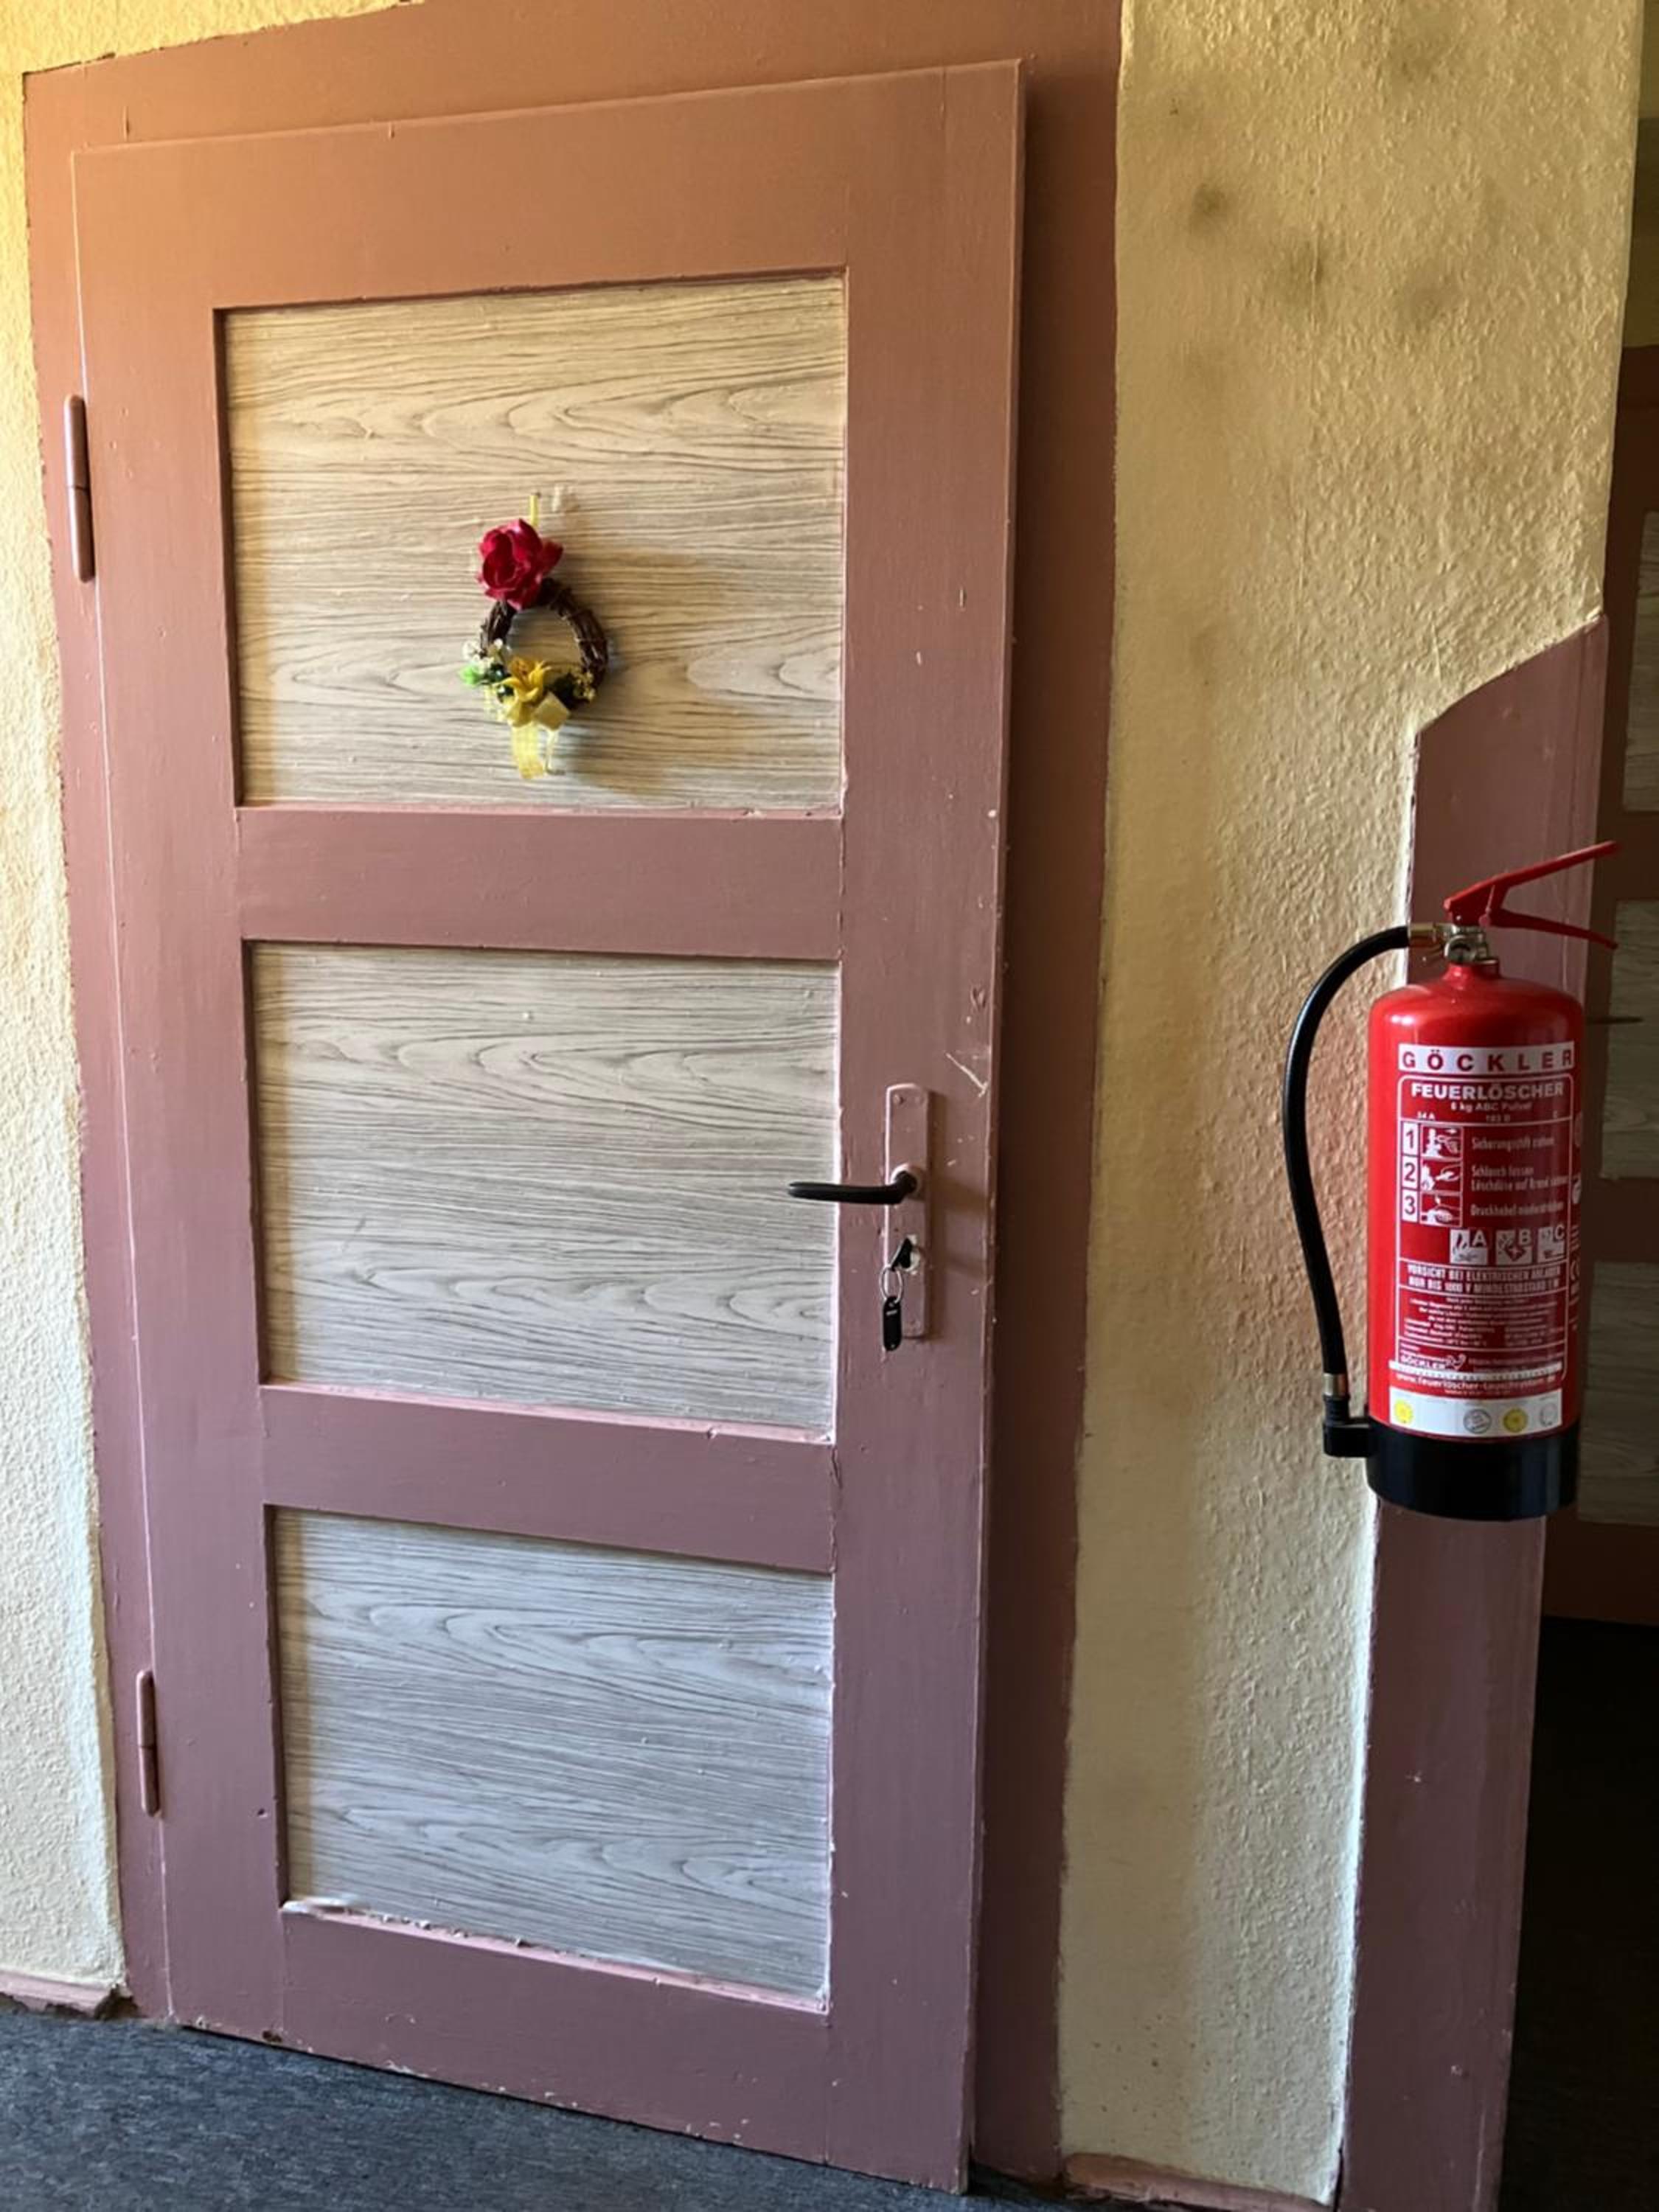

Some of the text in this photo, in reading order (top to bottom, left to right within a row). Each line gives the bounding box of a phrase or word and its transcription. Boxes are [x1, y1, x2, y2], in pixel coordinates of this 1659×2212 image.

[1402, 1049, 1572, 1071] GÖCKLER
[1411, 1082, 1564, 1100] FEUERLÖSCHER
[1459, 1102, 1473, 1113] kg
[1475, 1102, 1499, 1111] ABC
[1405, 1130, 1414, 1149] 1
[1404, 1162, 1416, 1183] 2
[1404, 1195, 1416, 1215] 3
[1472, 1230, 1487, 1245] A
[1519, 1228, 1532, 1245] B
[1554, 1225, 1565, 1240] C
